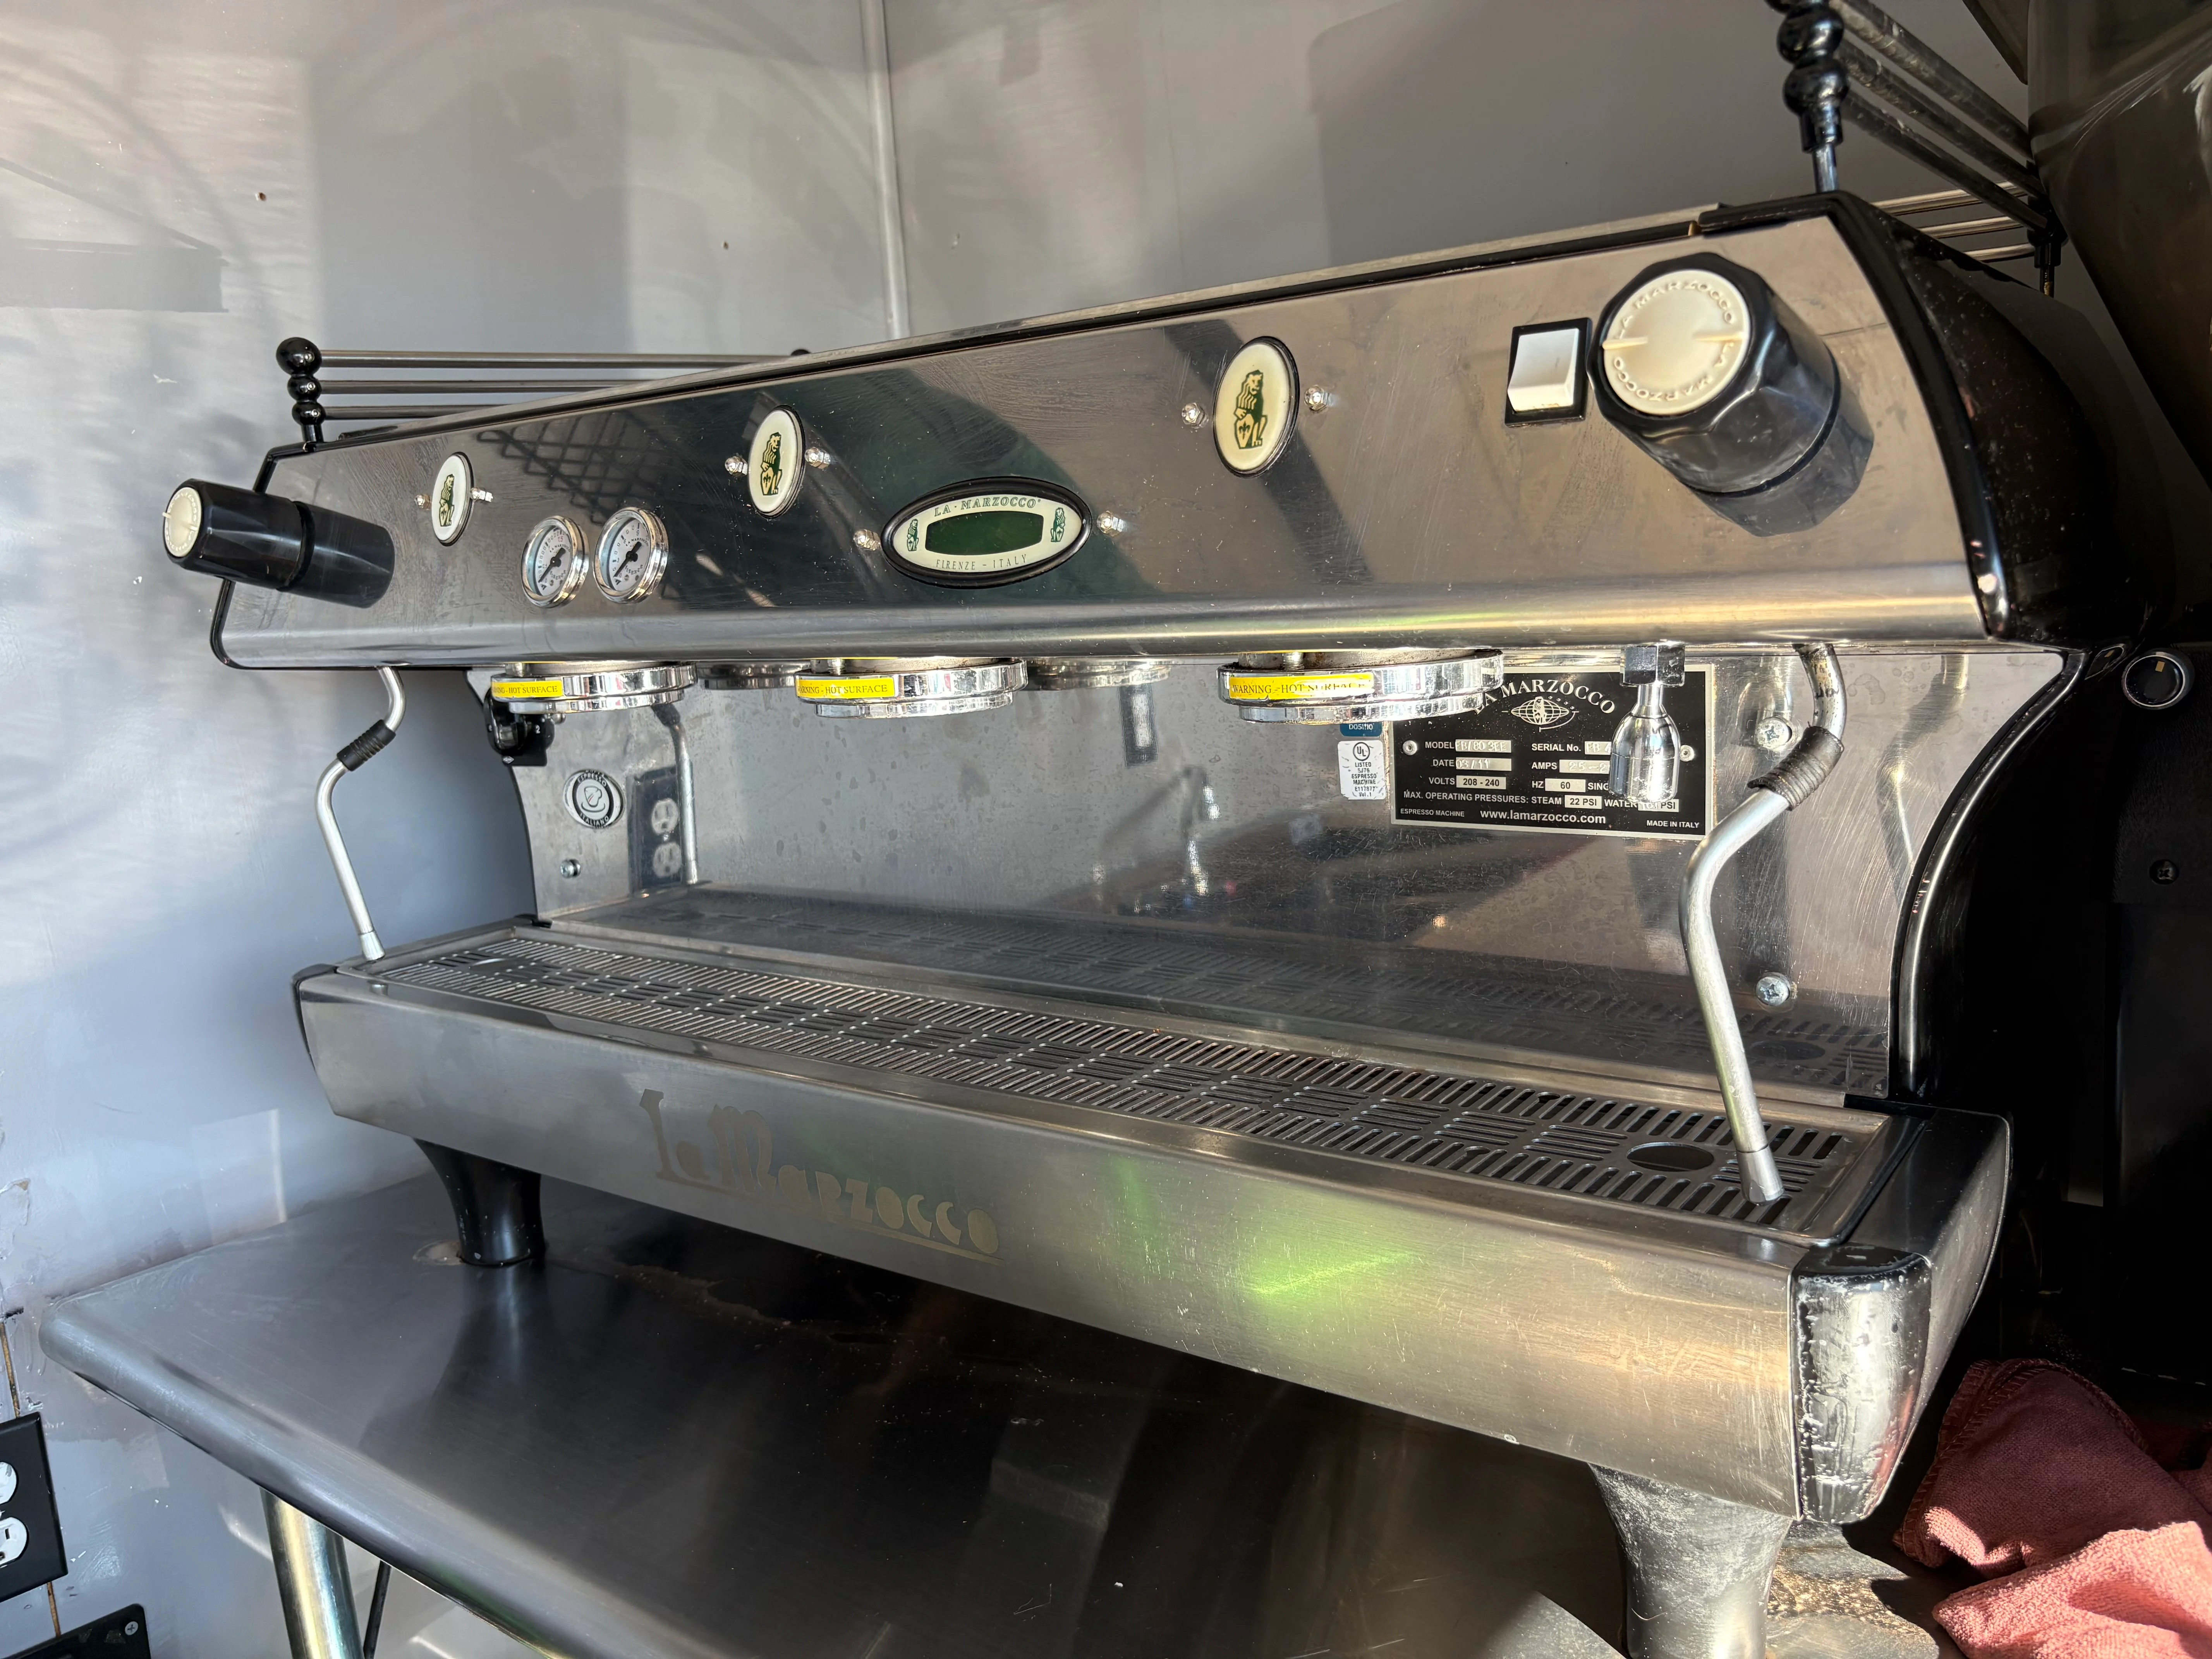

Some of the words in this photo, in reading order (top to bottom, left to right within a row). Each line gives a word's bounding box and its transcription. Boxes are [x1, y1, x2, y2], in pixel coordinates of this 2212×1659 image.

[1634, 280, 1735, 325] MARZOCCO
[934, 505, 951, 517] LA
[936, 559, 975, 570] FIRENZE
[993, 554, 1027, 568] ITALY
[844, 685, 888, 694] SURFACE
[1233, 684, 1272, 694] WARNING
[1500, 679, 1615, 714] MARZOCCO
[1531, 743, 1565, 752] SERIAL
[1566, 743, 1582, 752] No.
[1433, 759, 1454, 767] DATE
[1531, 762, 1557, 770] AMPS
[577, 772, 606, 787] ESPRESSO
[1429, 777, 1455, 785] VOLTS
[1403, 790, 1423, 799] MAX.
[1425, 792, 1472, 801] OPERATING
[1474, 794, 1528, 804] PRESSURES:
[1531, 796, 1562, 805] STEAM
[1604, 799, 1637, 808] WATER
[1661, 801, 1675, 809] PSI
[580, 813, 609, 827] ITALIANO
[1480, 809, 1606, 824] www.lamarzocco.com
